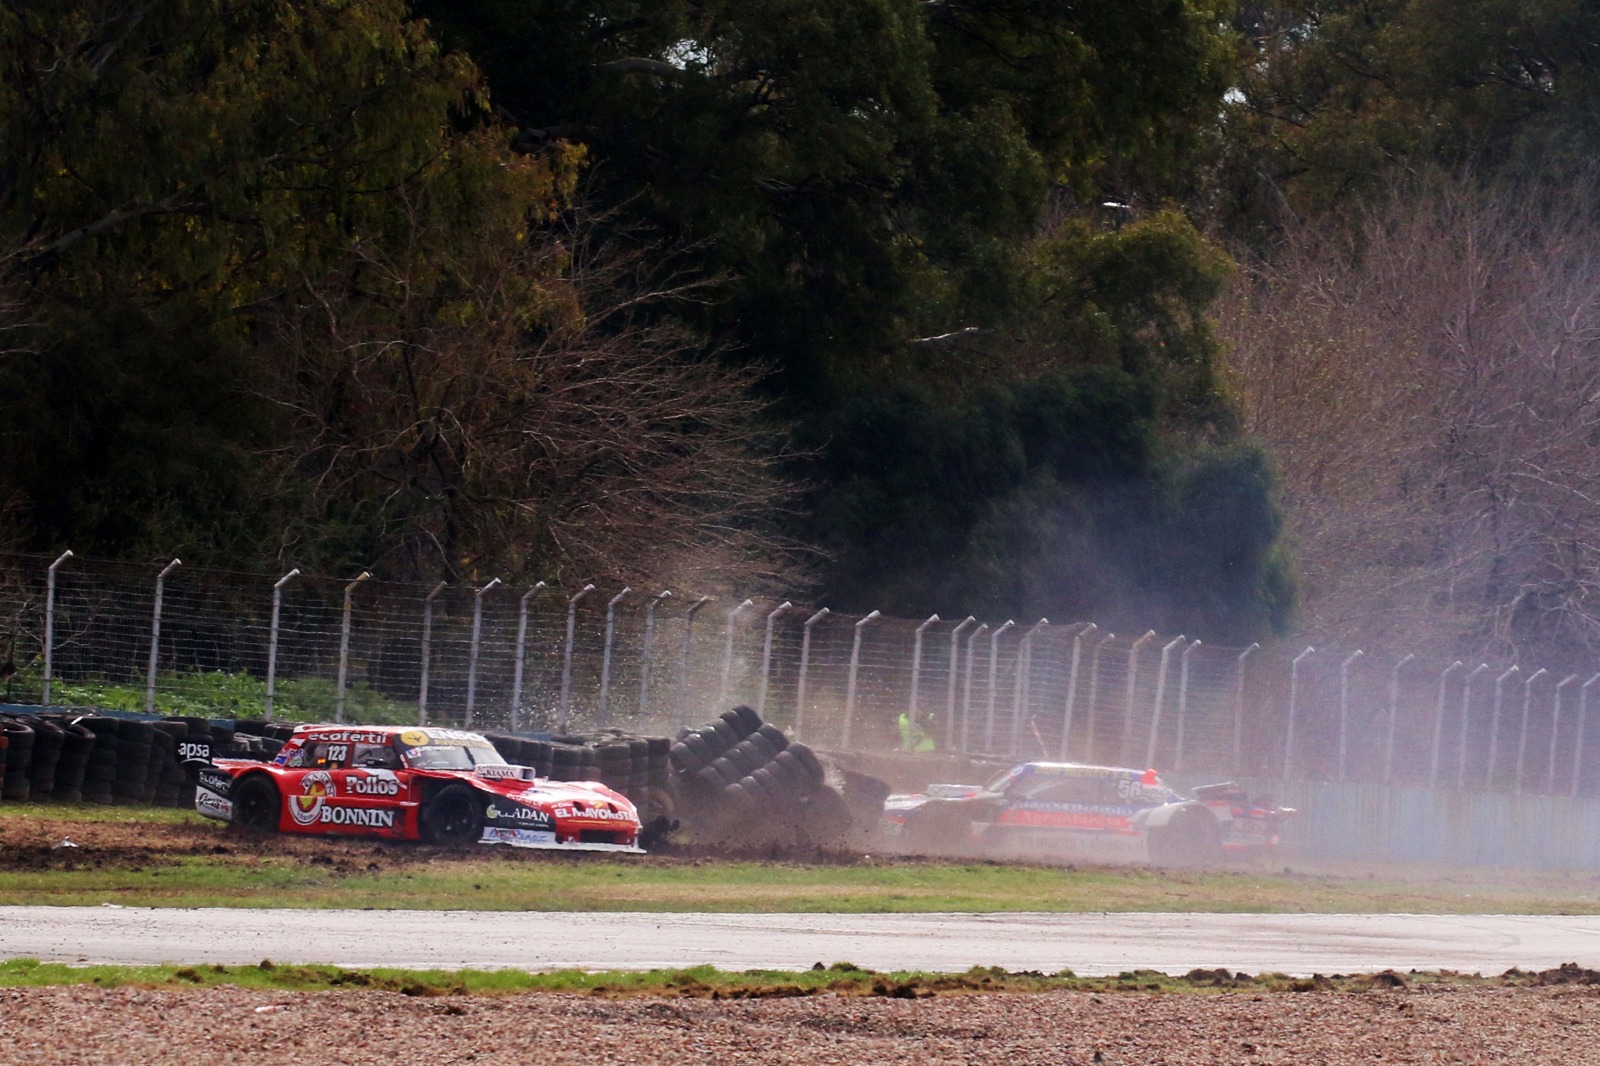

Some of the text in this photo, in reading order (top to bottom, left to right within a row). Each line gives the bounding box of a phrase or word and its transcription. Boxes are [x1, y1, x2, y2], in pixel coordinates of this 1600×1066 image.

[178, 742, 210, 759] apsa
[327, 745, 348, 762] 123
[346, 776, 399, 796] Pollos
[320, 805, 395, 828] BONNIN
[553, 807, 573, 819] EL
